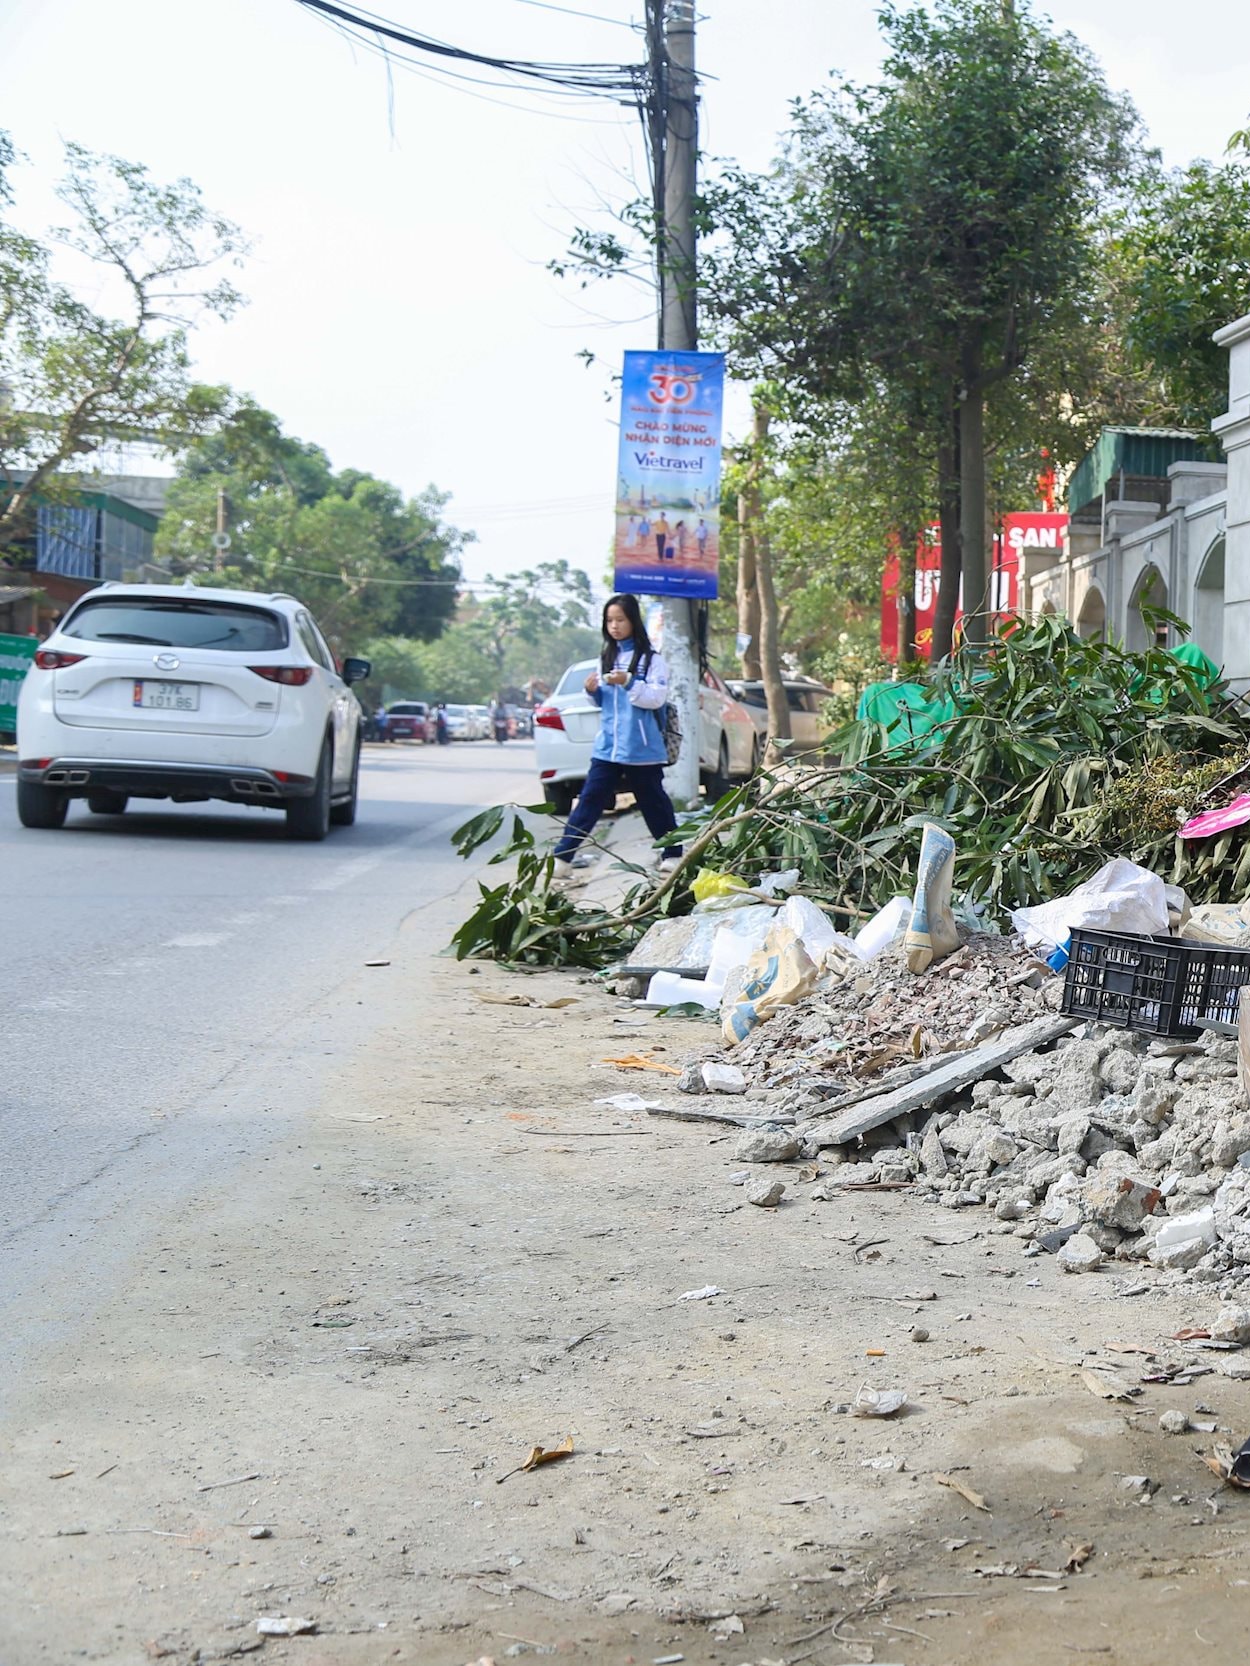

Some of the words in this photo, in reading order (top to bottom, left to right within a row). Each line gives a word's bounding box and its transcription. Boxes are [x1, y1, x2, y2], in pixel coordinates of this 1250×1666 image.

[648, 373, 695, 405] 30
[635, 420, 669, 431] CHÀO
[672, 421, 707, 433] MỪNG
[663, 435, 690, 446] DIỆN
[634, 451, 704, 469] Vietravel
[159, 683, 183, 695] 37K
